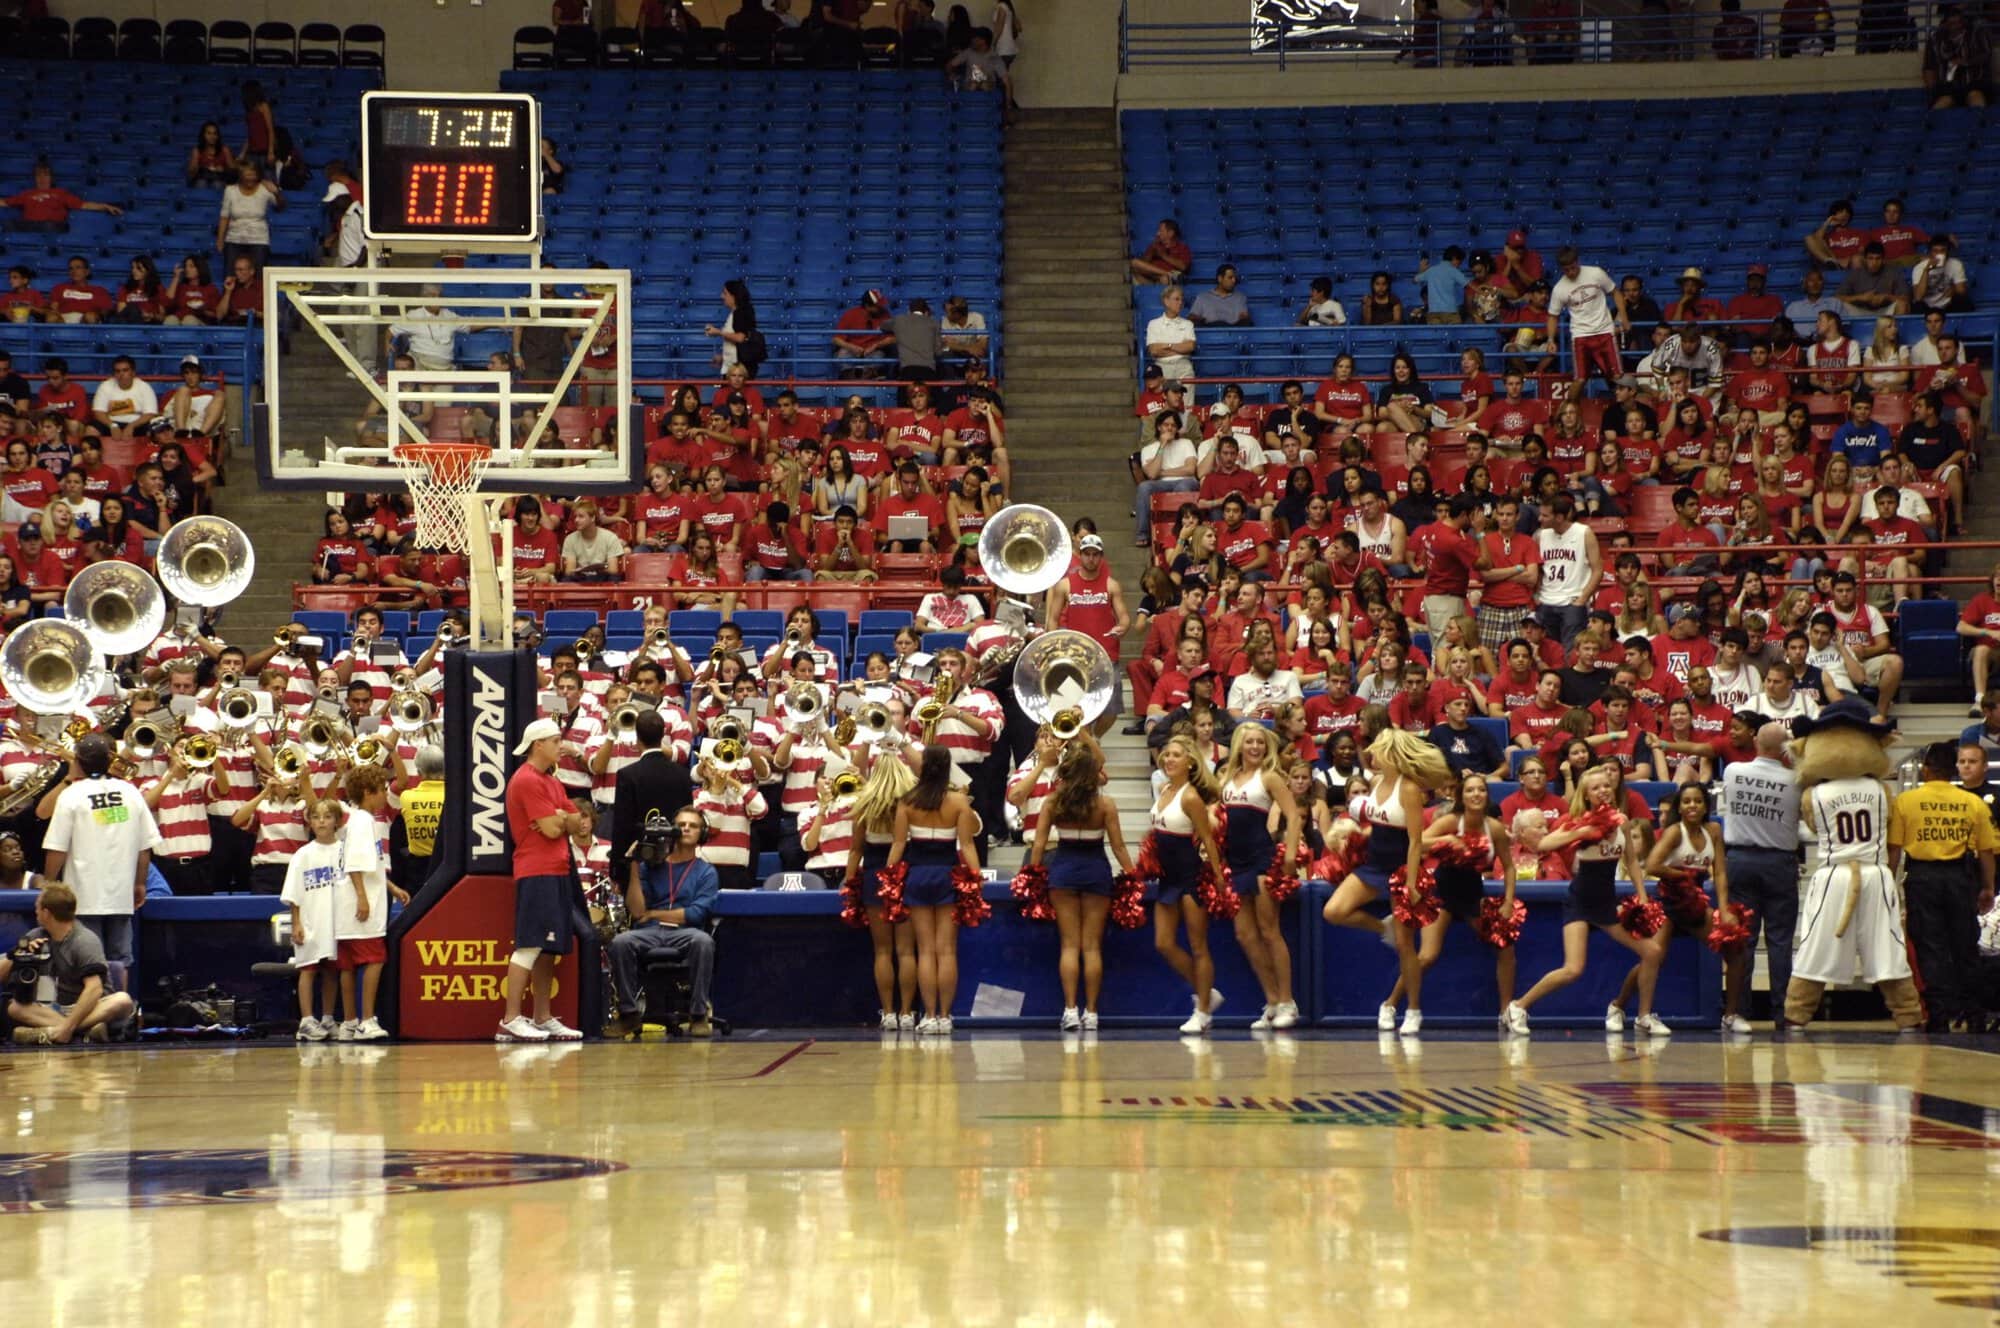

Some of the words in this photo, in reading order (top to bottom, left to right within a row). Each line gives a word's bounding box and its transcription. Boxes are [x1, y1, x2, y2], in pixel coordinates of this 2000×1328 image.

[418, 108, 514, 147] 7:29
[406, 163, 495, 225] 00
[1543, 548, 1577, 562] ARIZONA
[1548, 565, 1565, 582] 34
[632, 595, 653, 611] 21
[1716, 688, 1749, 705] IZONA
[471, 665, 505, 856] ARIZONA
[1735, 775, 1788, 792] EVENT
[87, 791, 123, 810] HS
[411, 800, 443, 810] EVEN
[1735, 790, 1783, 806] STAFF
[1829, 791, 1875, 809] WILBUR
[1919, 802, 1968, 811] EVENT
[413, 814, 438, 823] STA
[1730, 801, 1785, 822] SECURITY
[1836, 808, 1873, 844] 00
[1923, 816, 1968, 826] STAFF
[408, 826, 438, 840] SECU
[1916, 827, 1970, 841] SECURITY
